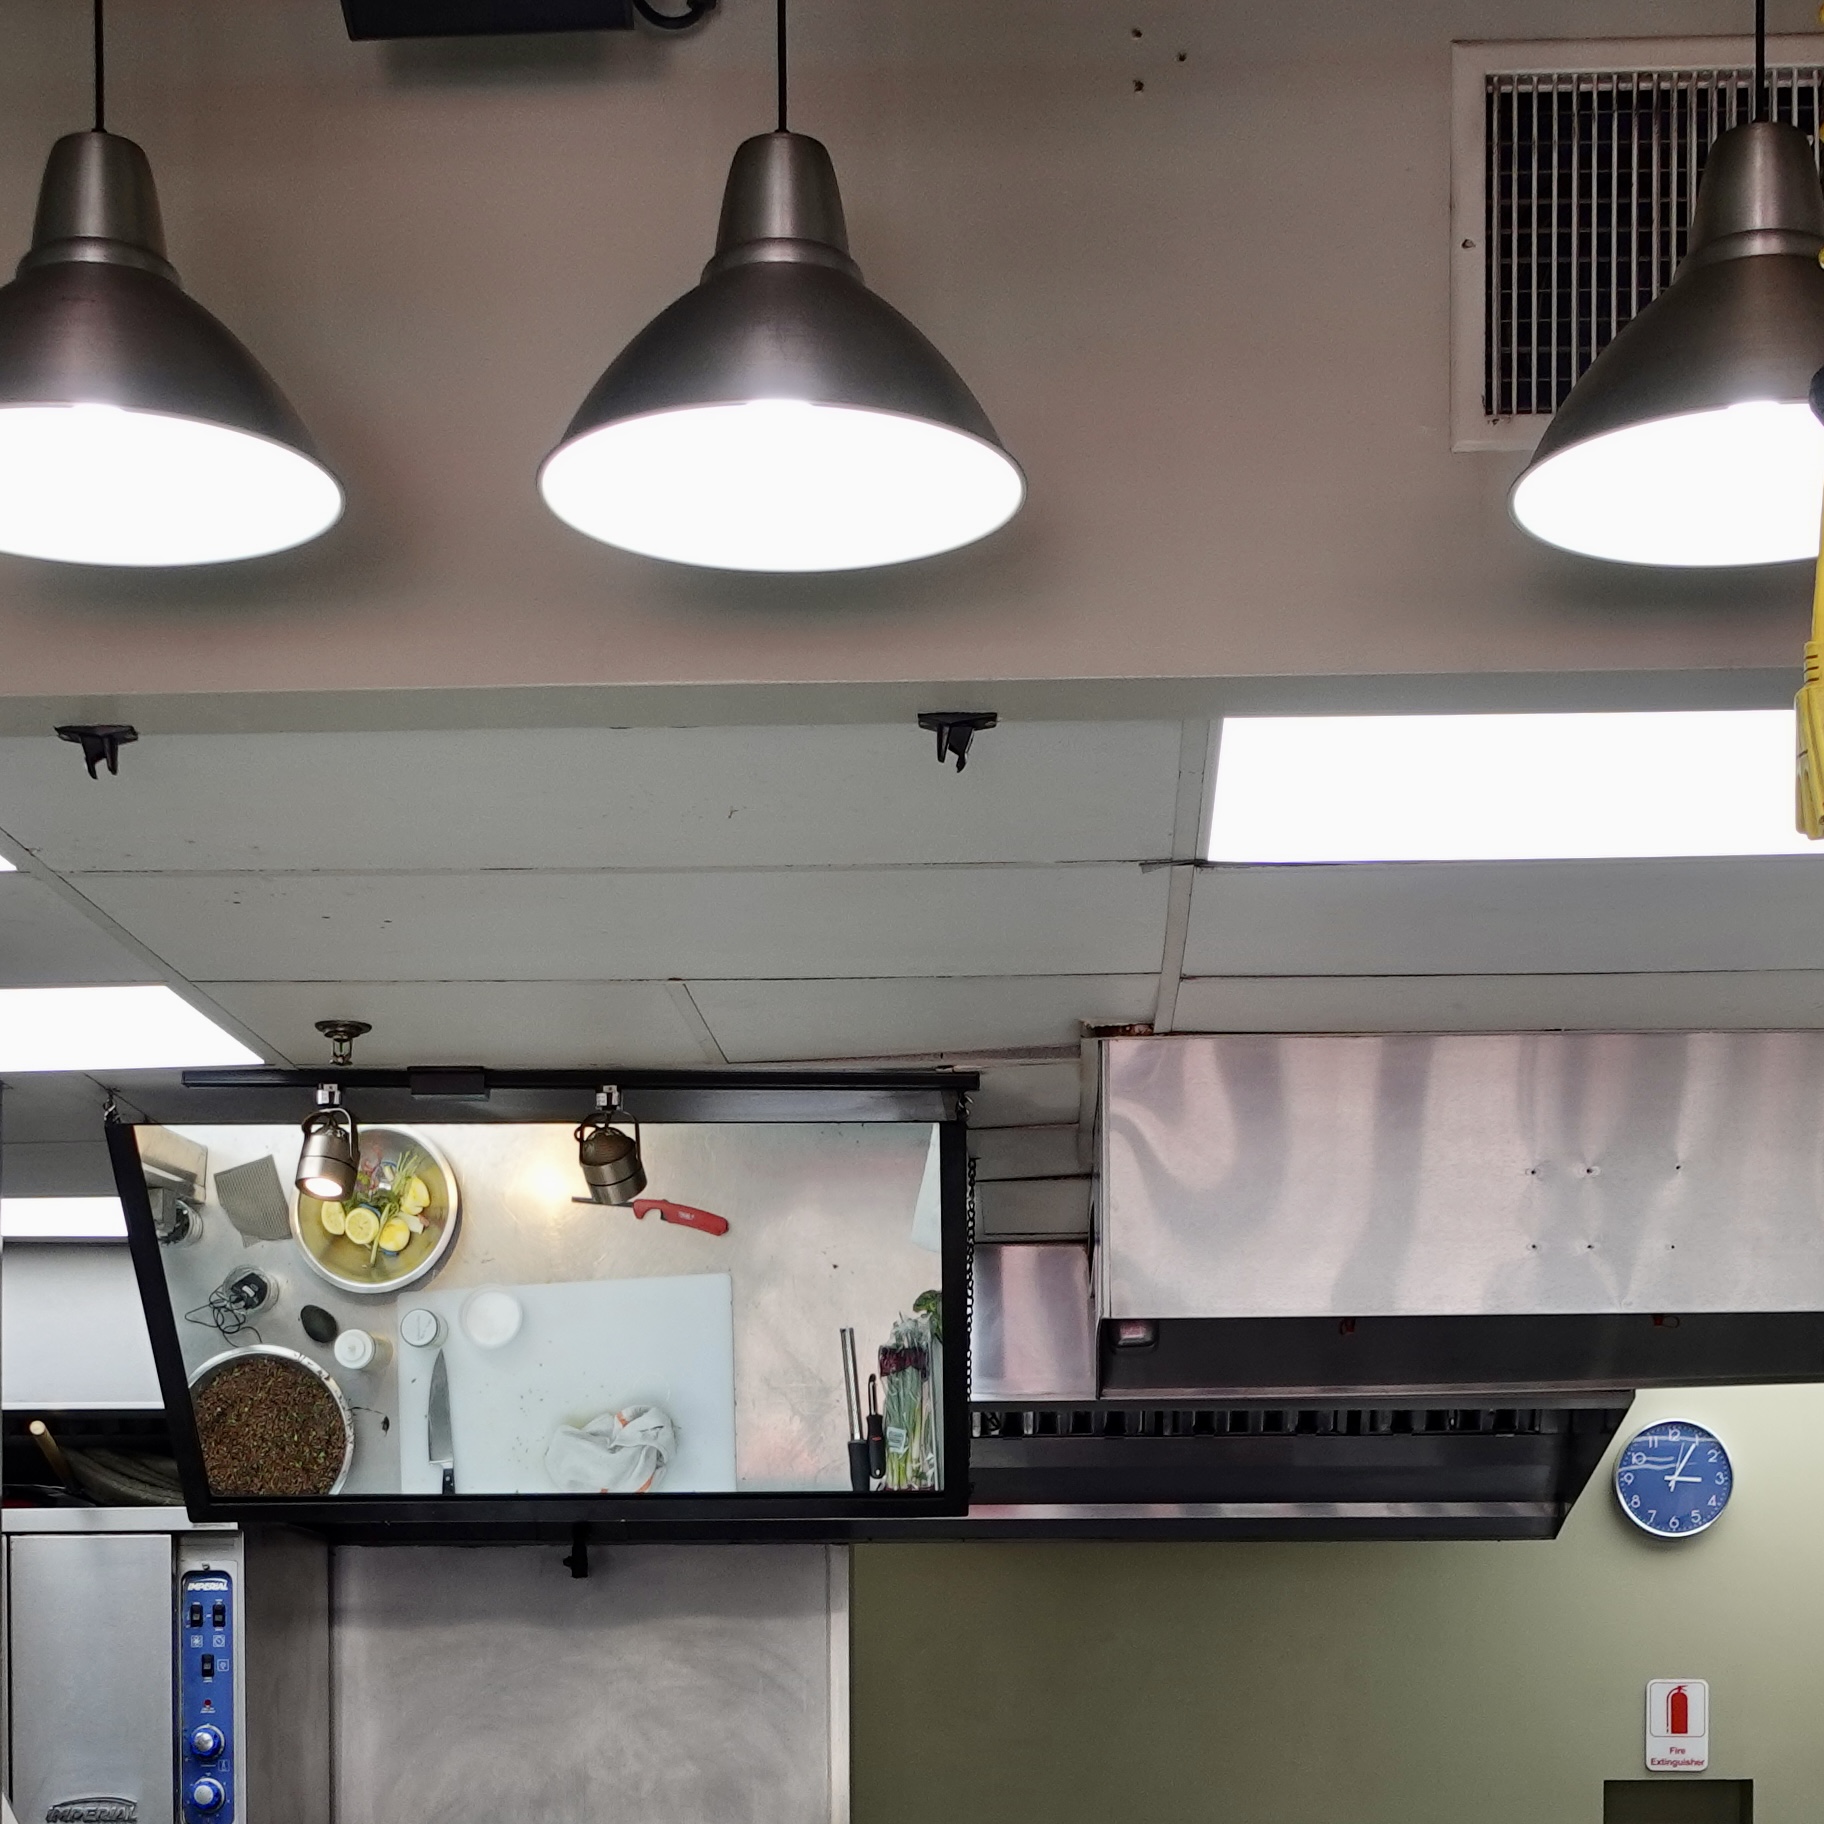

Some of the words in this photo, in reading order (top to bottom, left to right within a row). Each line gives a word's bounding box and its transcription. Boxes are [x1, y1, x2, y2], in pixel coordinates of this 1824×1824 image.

[1648, 1435, 1659, 1449] 11
[1668, 1428, 1681, 1442] 12
[1631, 1451, 1647, 1465] 10
[1707, 1449, 1721, 1463] 2
[1623, 1472, 1635, 1486] 9
[1714, 1471, 1726, 1485] 3
[1630, 1494, 1641, 1508] 8
[1707, 1494, 1717, 1507] 4
[1647, 1510, 1657, 1524] 7
[1668, 1515, 1680, 1529] 6
[1690, 1510, 1702, 1523] 5
[187, 1581, 229, 1591] IMPERIAL
[1669, 1746, 1686, 1755] Fire
[1650, 1757, 1705, 1768] Extinguisher
[45, 1806, 138, 1824] IMPERIAL
